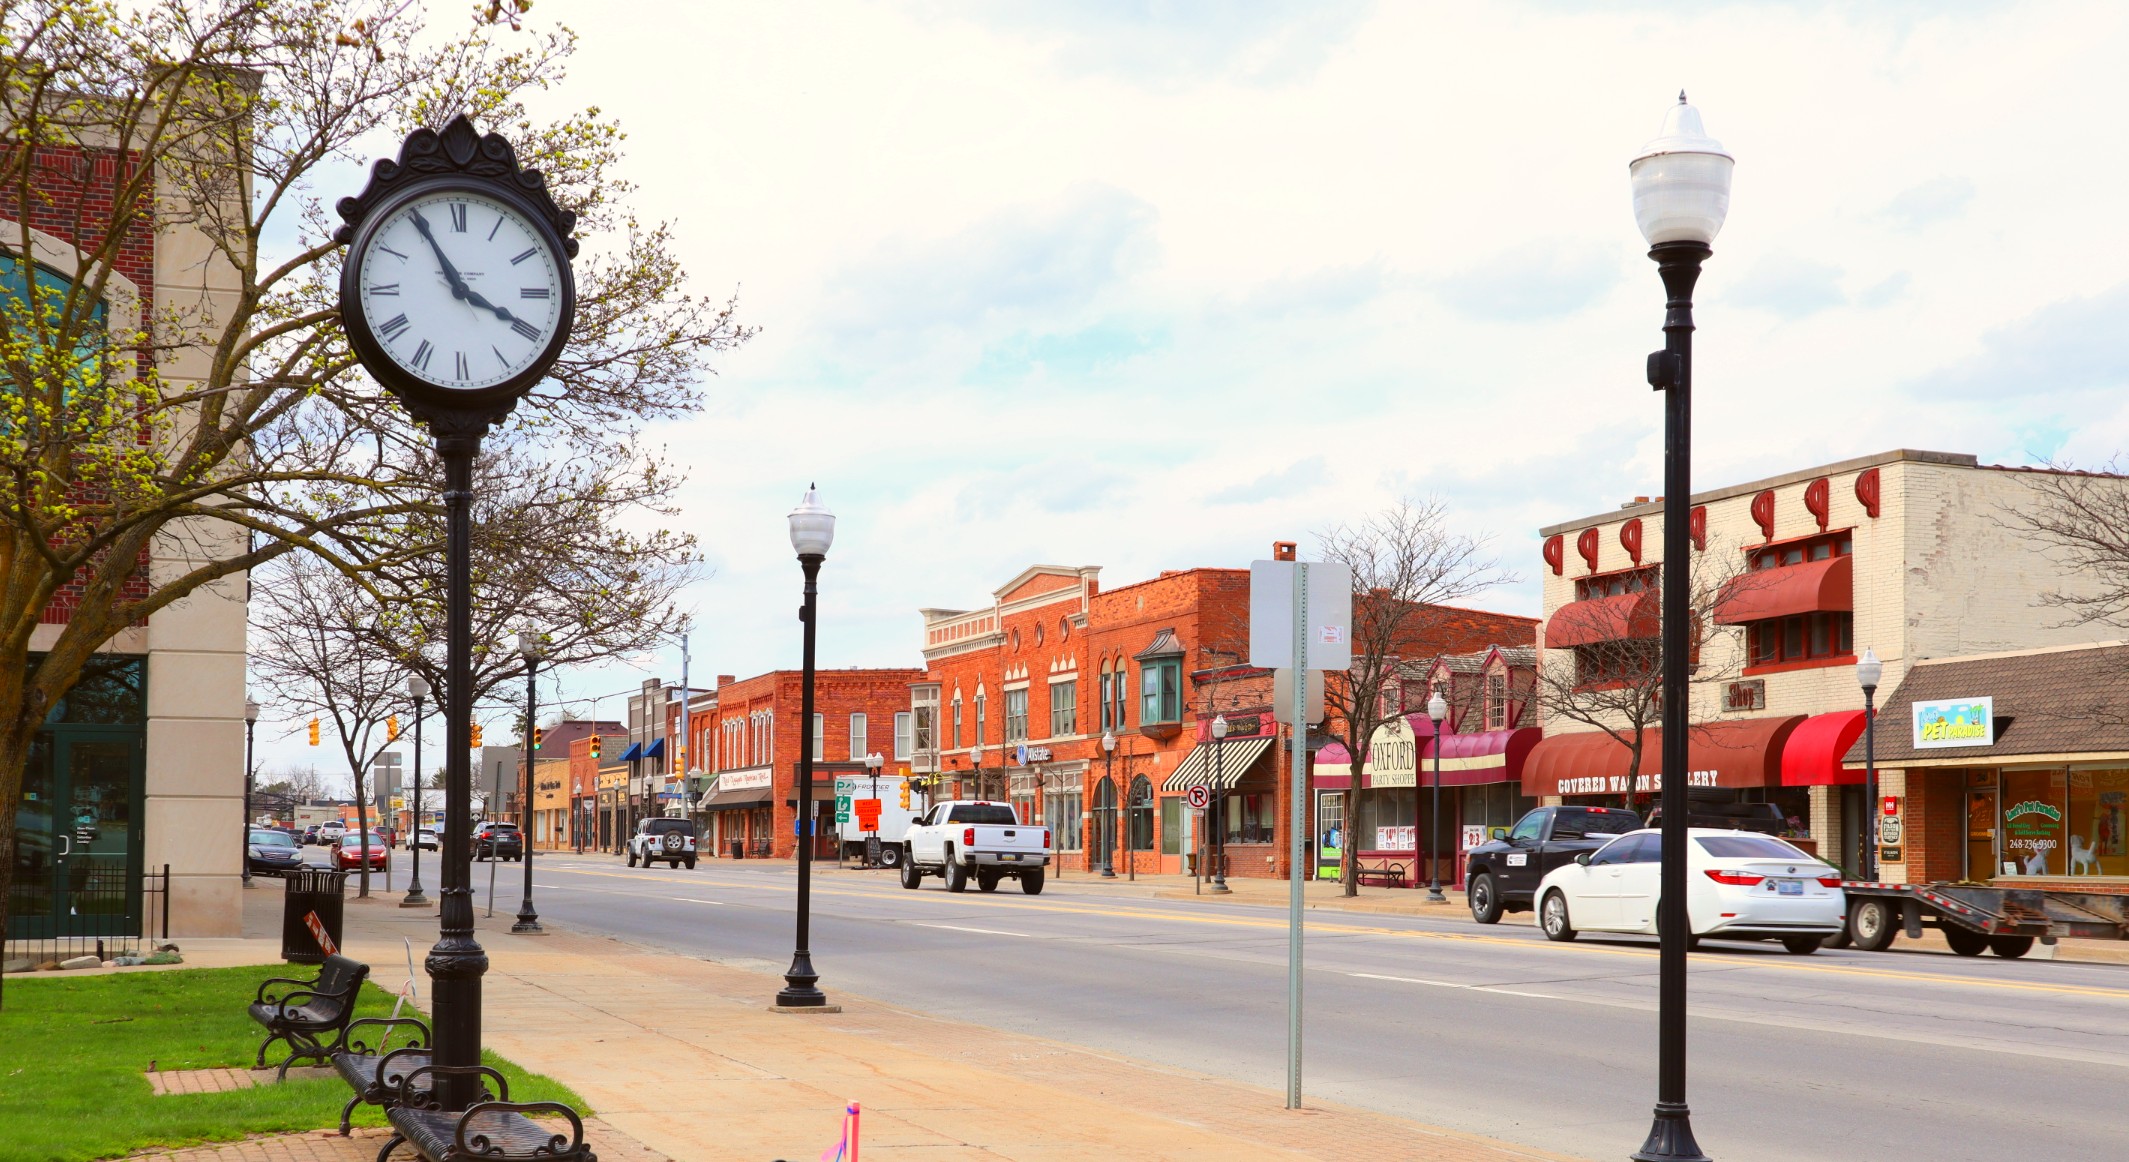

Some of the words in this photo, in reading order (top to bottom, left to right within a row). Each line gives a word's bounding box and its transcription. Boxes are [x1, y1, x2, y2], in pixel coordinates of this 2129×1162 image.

[1729, 683, 1754, 711] Shop
[1923, 721, 1949, 741] PET
[1949, 724, 1985, 739] PARADISE
[1028, 746, 1051, 761] Allstate
[1373, 741, 1415, 771] OXFORD
[1372, 774, 1389, 785] PARTY
[1391, 773, 1415, 785] SHOPPE
[1558, 776, 1606, 794] COVERED
[1609, 774, 1650, 792] WAON
[2010, 839, 2057, 849] 248-236-9300
